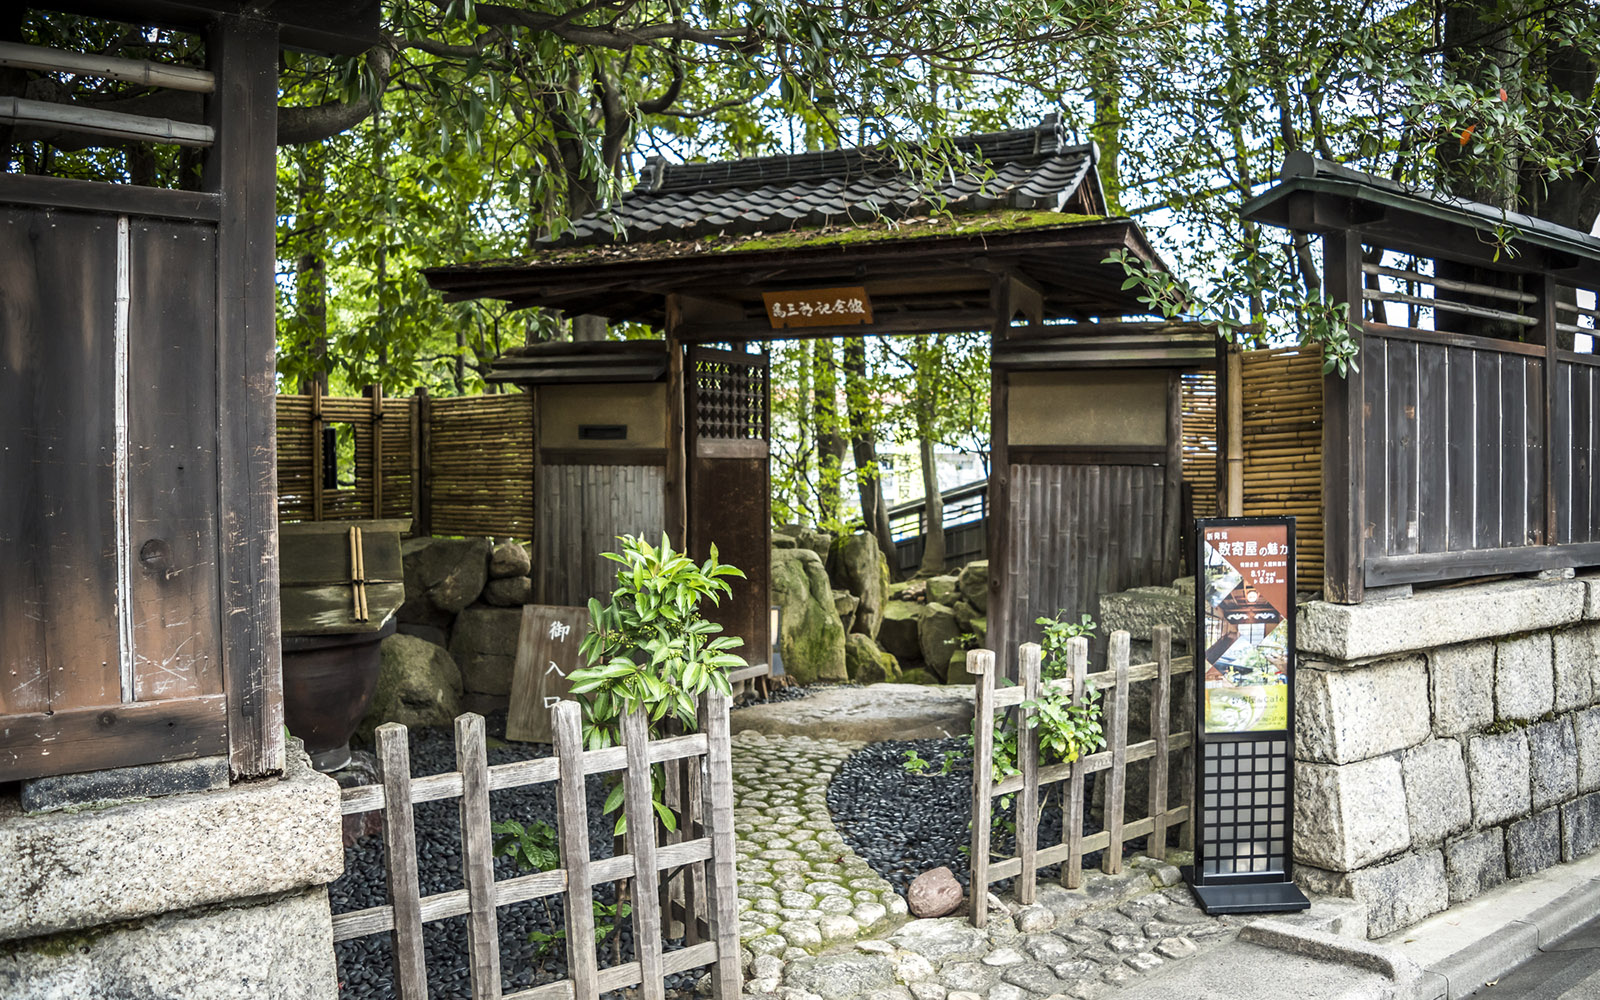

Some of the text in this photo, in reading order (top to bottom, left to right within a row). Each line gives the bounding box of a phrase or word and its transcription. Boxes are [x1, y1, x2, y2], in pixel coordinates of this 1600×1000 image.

[1206, 532, 1227, 540] 新発見
[1219, 541, 1288, 556] 数寄屋の魅力
[543, 620, 570, 709] 御入口
